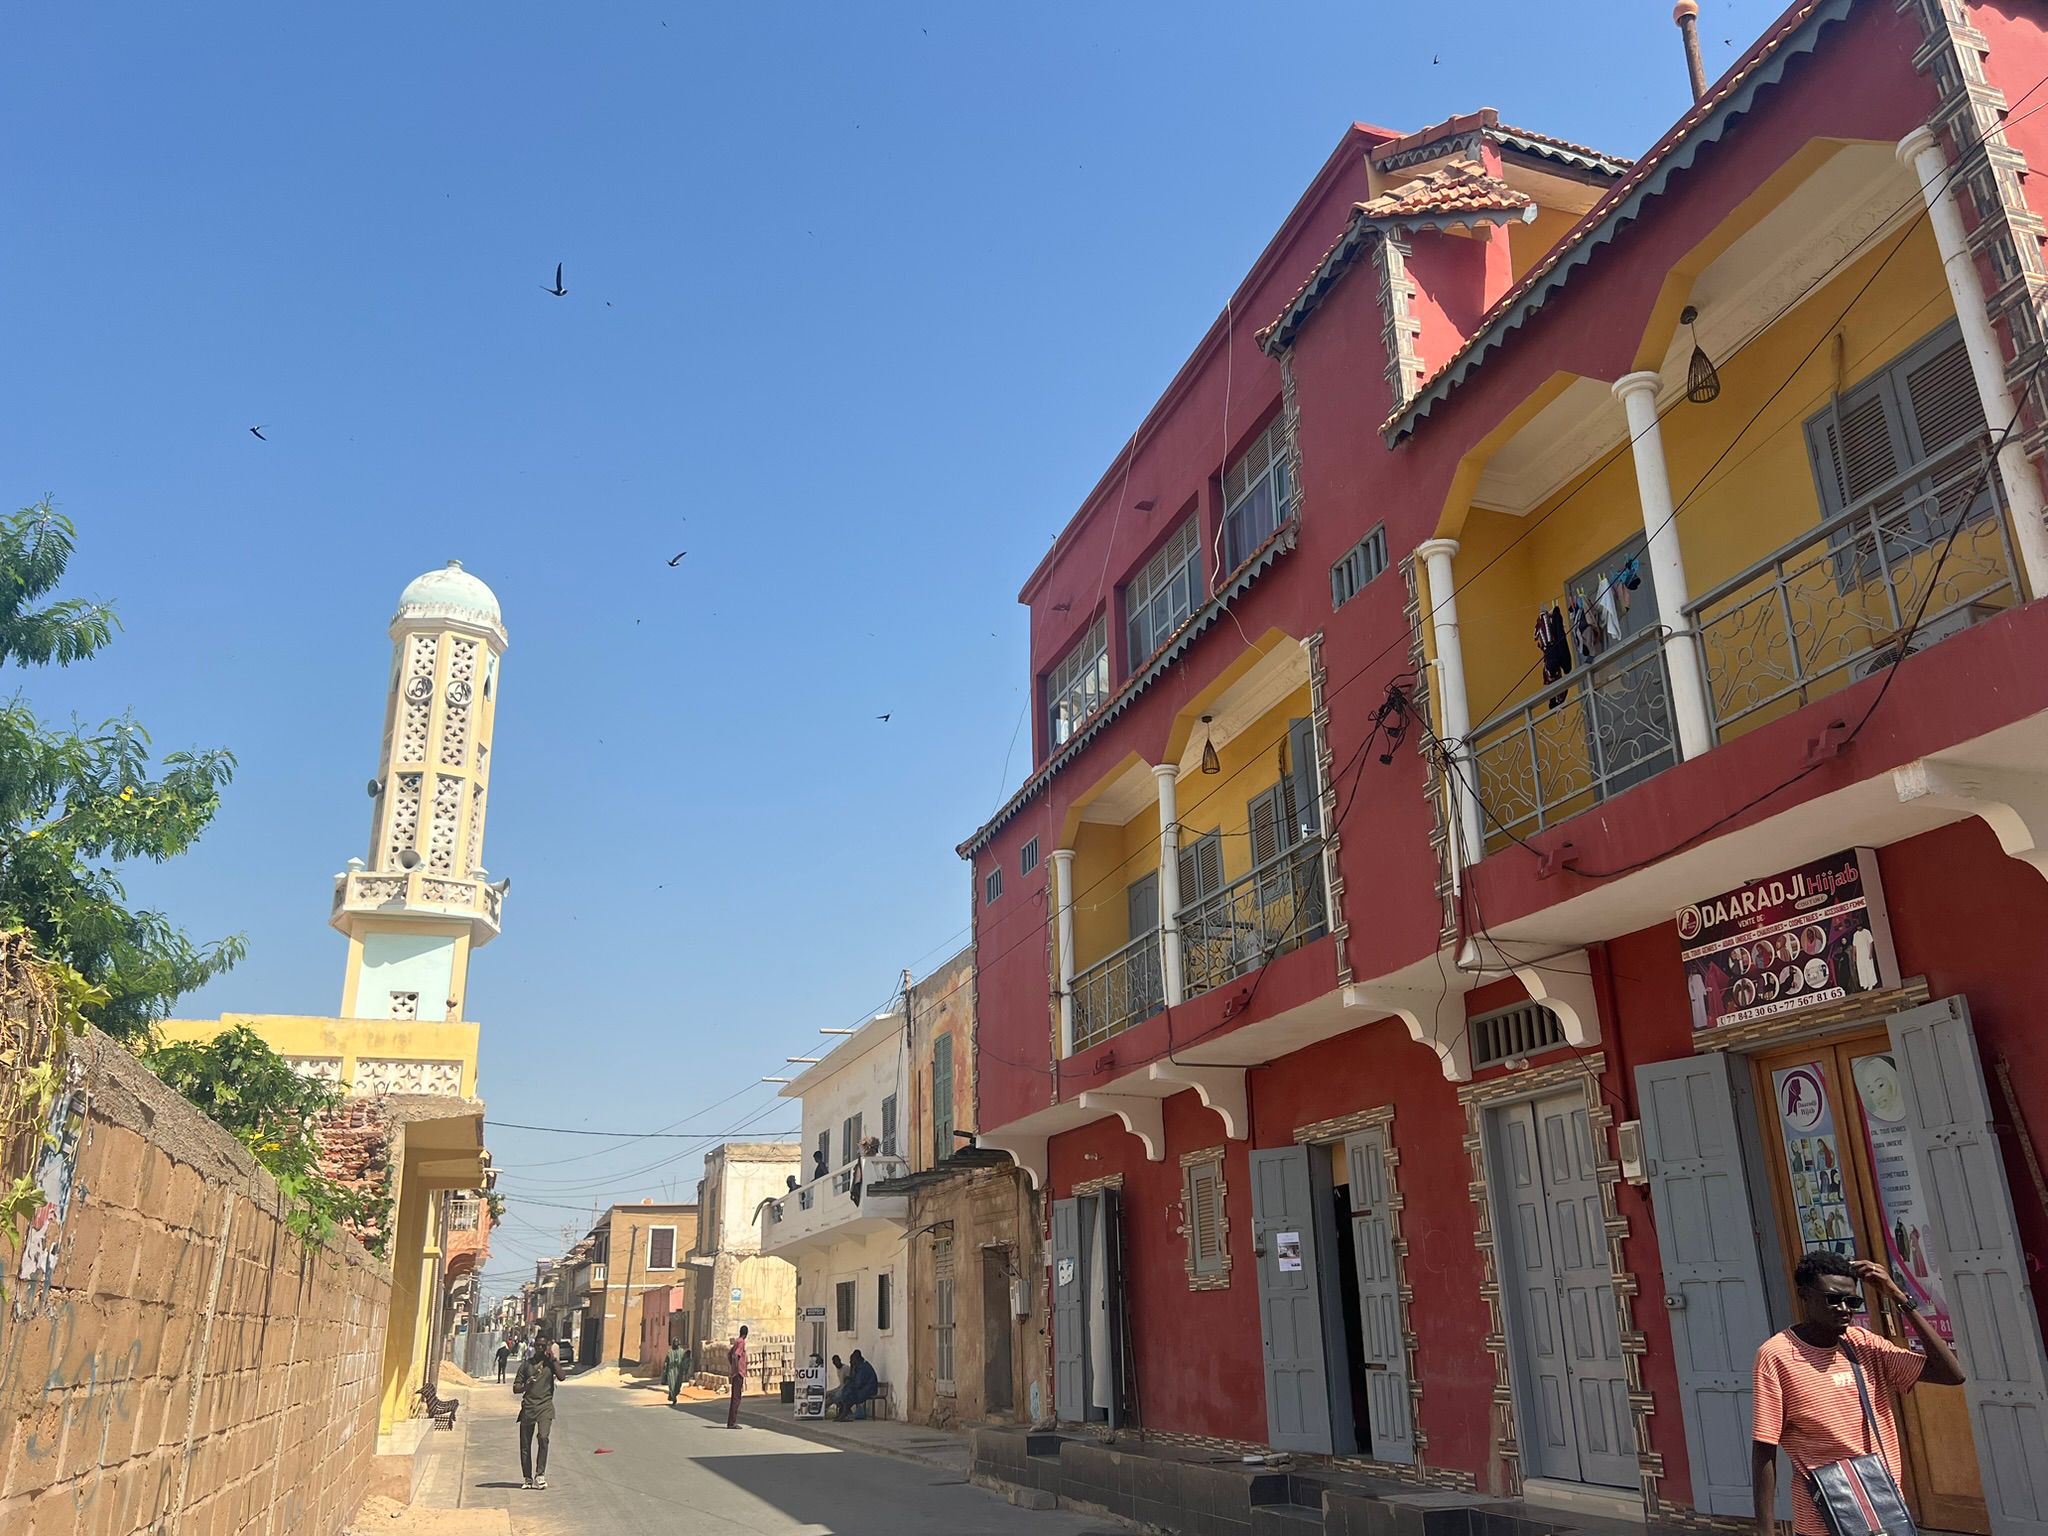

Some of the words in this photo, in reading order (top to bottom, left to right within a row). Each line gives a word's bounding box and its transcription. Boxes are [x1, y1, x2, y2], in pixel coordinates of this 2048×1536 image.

[1702, 874, 1806, 928] DAARADJI
[1808, 862, 1858, 896] Hijab
[1849, 898, 1866, 909] FEMME
[1737, 916, 1756, 928] VENTE
[1727, 1015, 1736, 1023] 77
[1738, 1010, 1753, 1021] 842
[1755, 1008, 1765, 1017] 30
[1767, 1005, 1778, 1014] 63
[1784, 1000, 1795, 1010] 77
[1798, 996, 1814, 1007] 567
[1817, 992, 1828, 1002] 81
[1830, 989, 1843, 998] 65
